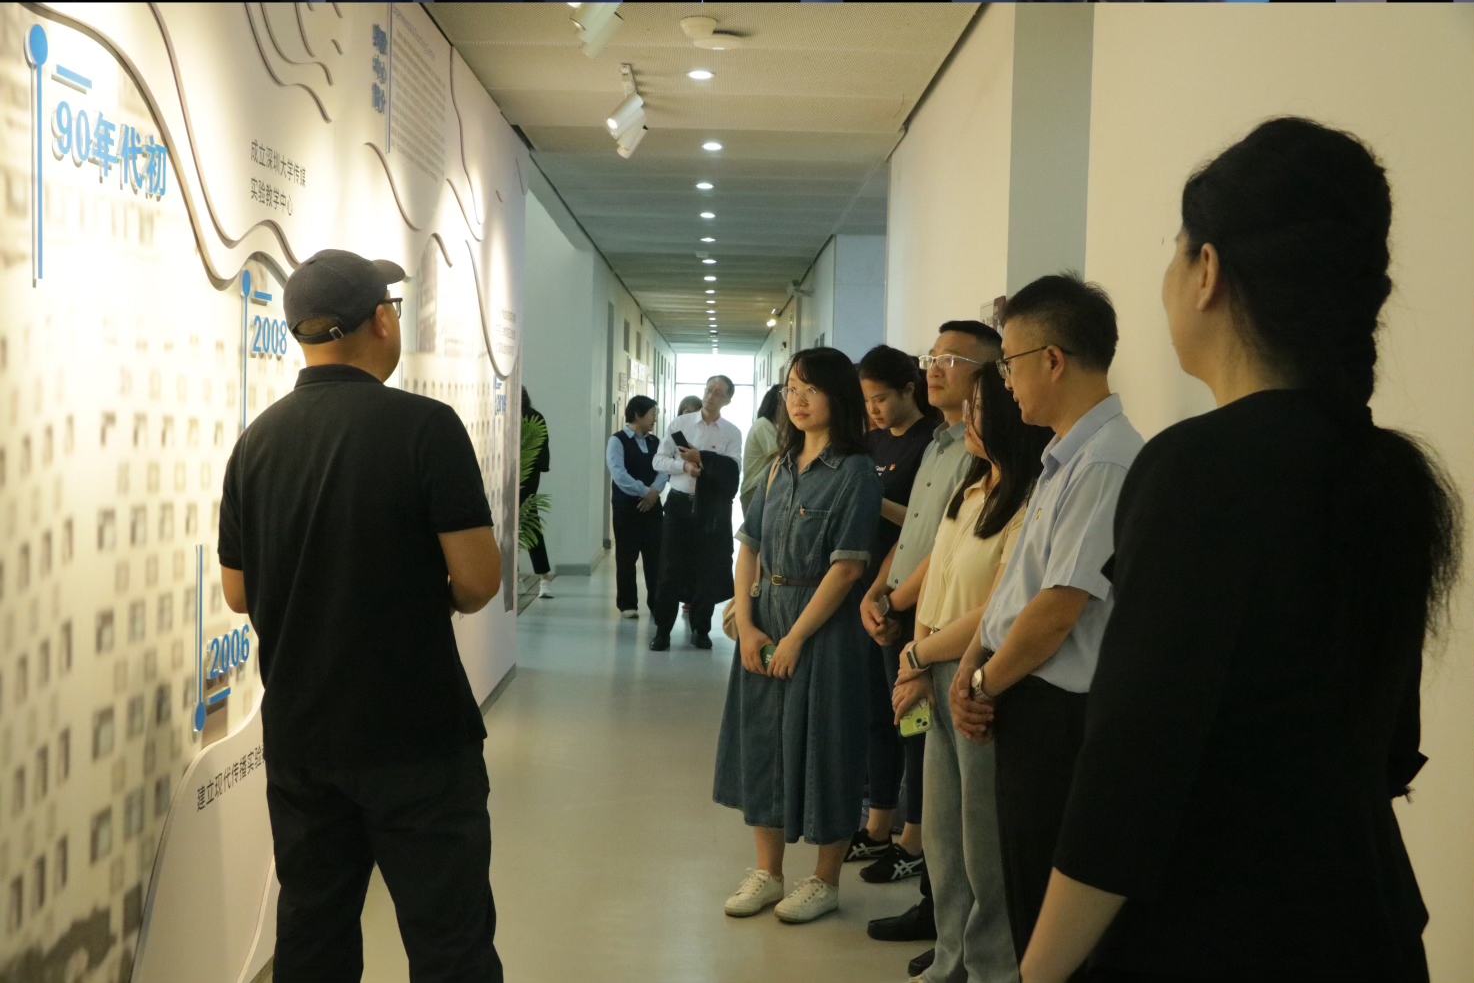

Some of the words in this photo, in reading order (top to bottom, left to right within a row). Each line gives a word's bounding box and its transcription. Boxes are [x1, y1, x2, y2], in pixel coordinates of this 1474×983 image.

[56, 101, 167, 196] 90年代初
[252, 315, 289, 356] 2008
[209, 624, 250, 680] 2006
[196, 744, 265, 813] 建立现代传播实验
